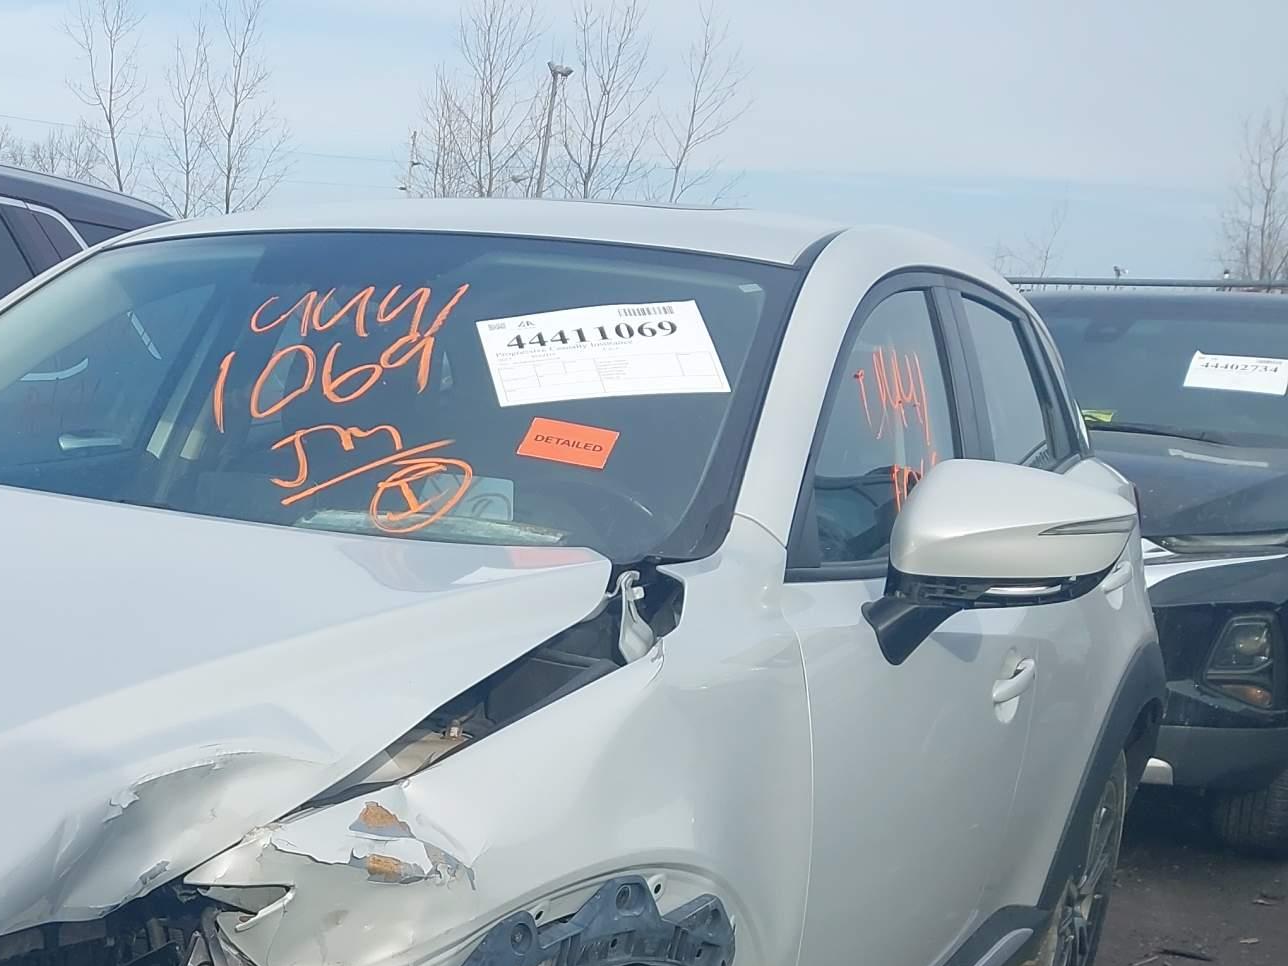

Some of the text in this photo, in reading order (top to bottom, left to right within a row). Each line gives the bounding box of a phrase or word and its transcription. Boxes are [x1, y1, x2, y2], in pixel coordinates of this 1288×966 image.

[507, 320, 678, 349] 44411069
[1200, 361, 1279, 373] 44402734
[212, 335, 436, 434] 1069
[534, 434, 604, 452] DETAILED
